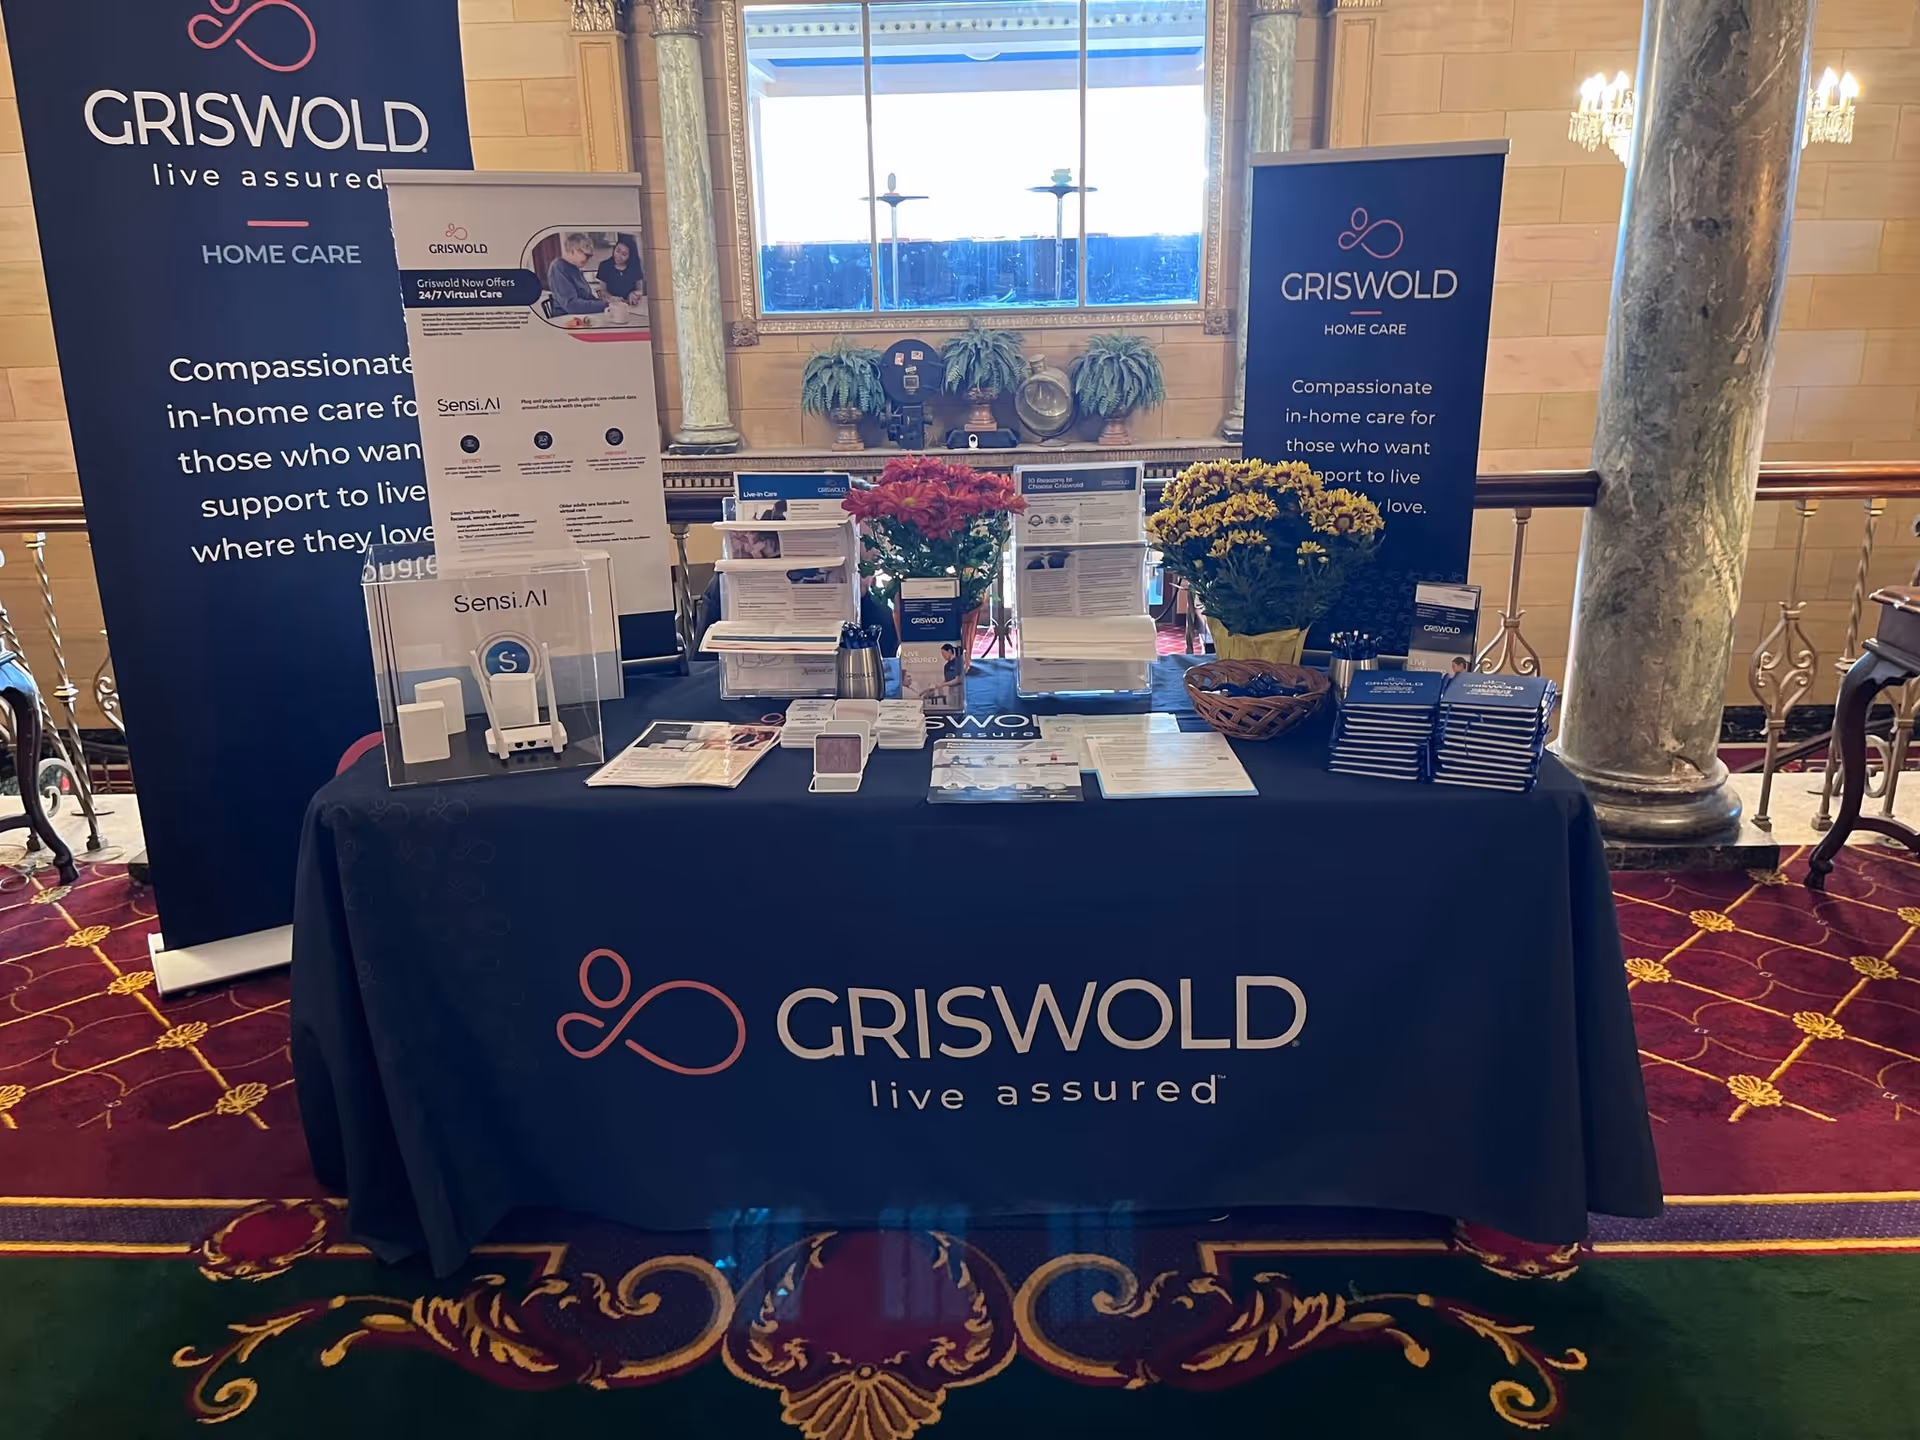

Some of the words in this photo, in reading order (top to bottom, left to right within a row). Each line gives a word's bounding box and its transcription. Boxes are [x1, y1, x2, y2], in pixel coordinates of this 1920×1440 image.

[84, 89, 428, 153] GRISWOLD
[153, 164, 220, 187] live
[241, 168, 383, 190] assured
[202, 244, 285, 264] HOME
[291, 245, 362, 265] CARE
[428, 244, 488, 254] GRISWOLD
[417, 279, 460, 288] Griswold
[462, 278, 484, 288] Now
[486, 278, 515, 287] Offers
[1281, 269, 1459, 301] GRISWOLD
[418, 290, 442, 300] 24/7
[444, 290, 478, 299] Virtual
[480, 290, 503, 298] Care
[1324, 323, 1366, 336] HOME
[1369, 323, 1407, 336] CARE
[169, 353, 413, 384] Compassionate
[1291, 378, 1432, 397] Compassionate
[166, 402, 308, 429] in-home
[318, 400, 384, 422] care
[391, 395, 418, 418] fo
[438, 397, 500, 412] Sensi.AI
[1285, 409, 1361, 425] in-home
[1366, 411, 1406, 425] care
[1410, 409, 1437, 426] for
[1286, 438, 1335, 453] those
[1340, 439, 1379, 454] who
[1385, 440, 1431, 455] want
[177, 449, 273, 475] those
[281, 443, 350, 467] who
[358, 442, 422, 463] wan
[1313, 469, 1362, 484] pport
[1367, 470, 1385, 483] to
[1390, 469, 1421, 484] live
[201, 489, 331, 521] support
[337, 487, 369, 507] to
[377, 481, 427, 505] live
[1387, 498, 1427, 514] love.
[191, 537, 295, 564] where
[303, 529, 372, 555] they
[453, 588, 549, 613] Sensi.AI
[1423, 624, 1461, 634] GRISWOLD
[776, 974, 1308, 1060] GRISWOLD
[870, 1078, 964, 1110] live
